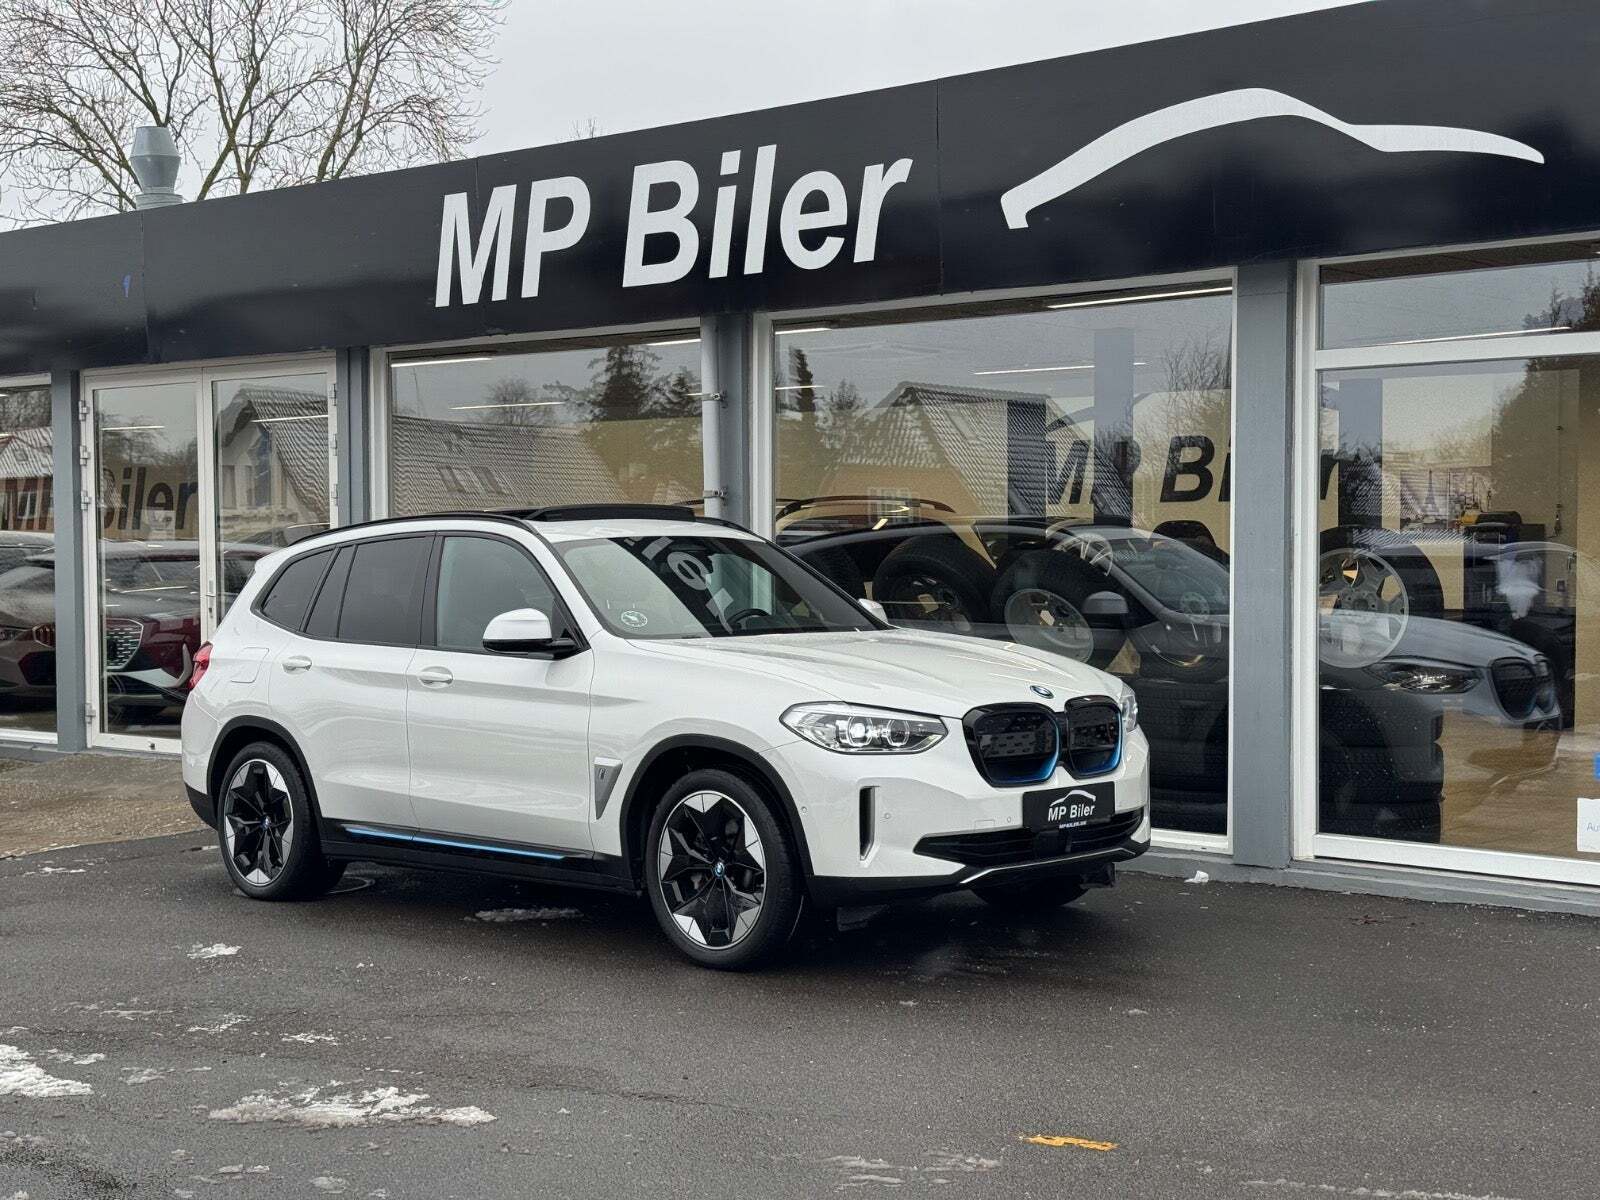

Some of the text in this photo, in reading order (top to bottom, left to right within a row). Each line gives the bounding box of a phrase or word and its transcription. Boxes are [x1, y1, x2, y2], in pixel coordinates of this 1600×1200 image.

[435, 144, 913, 307] MP Biler
[1048, 803, 1095, 822] MP Biler
